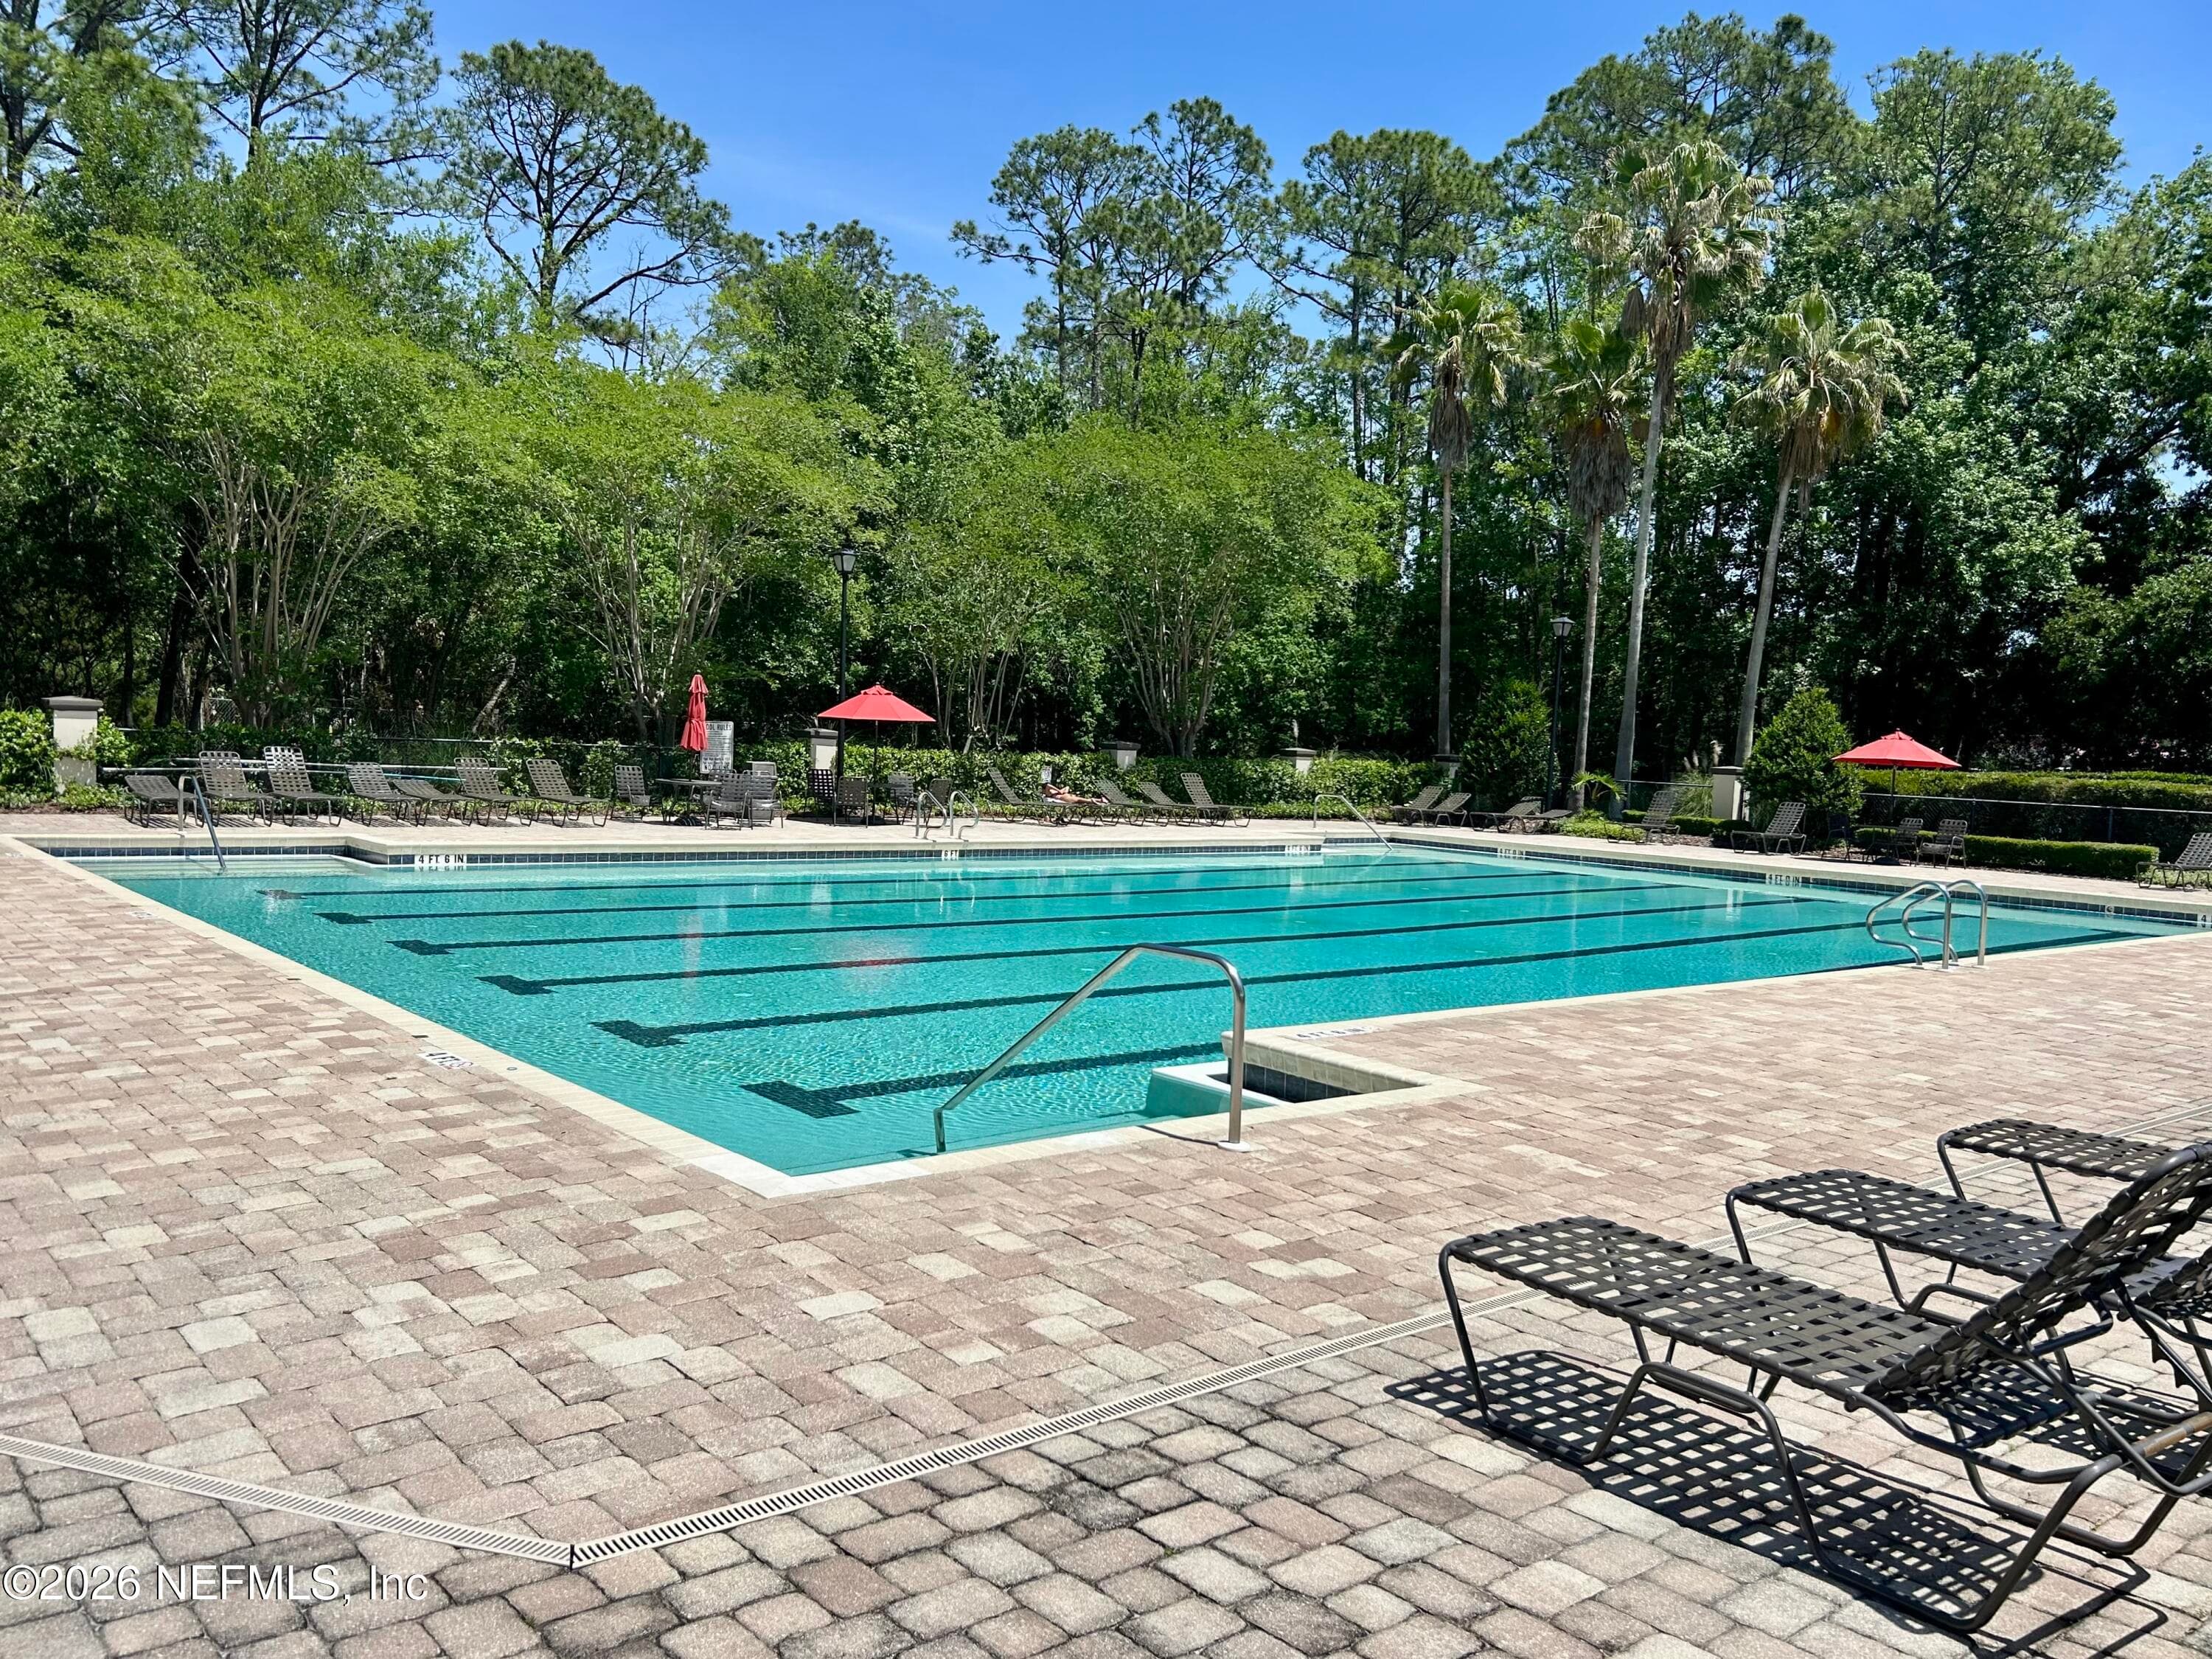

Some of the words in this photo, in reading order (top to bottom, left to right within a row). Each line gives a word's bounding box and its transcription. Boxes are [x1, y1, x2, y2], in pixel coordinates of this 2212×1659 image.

[717, 723, 731, 731] RULES
[418, 855, 425, 864] 4
[445, 855, 450, 863] 6
[2201, 914, 2207, 922] 4
